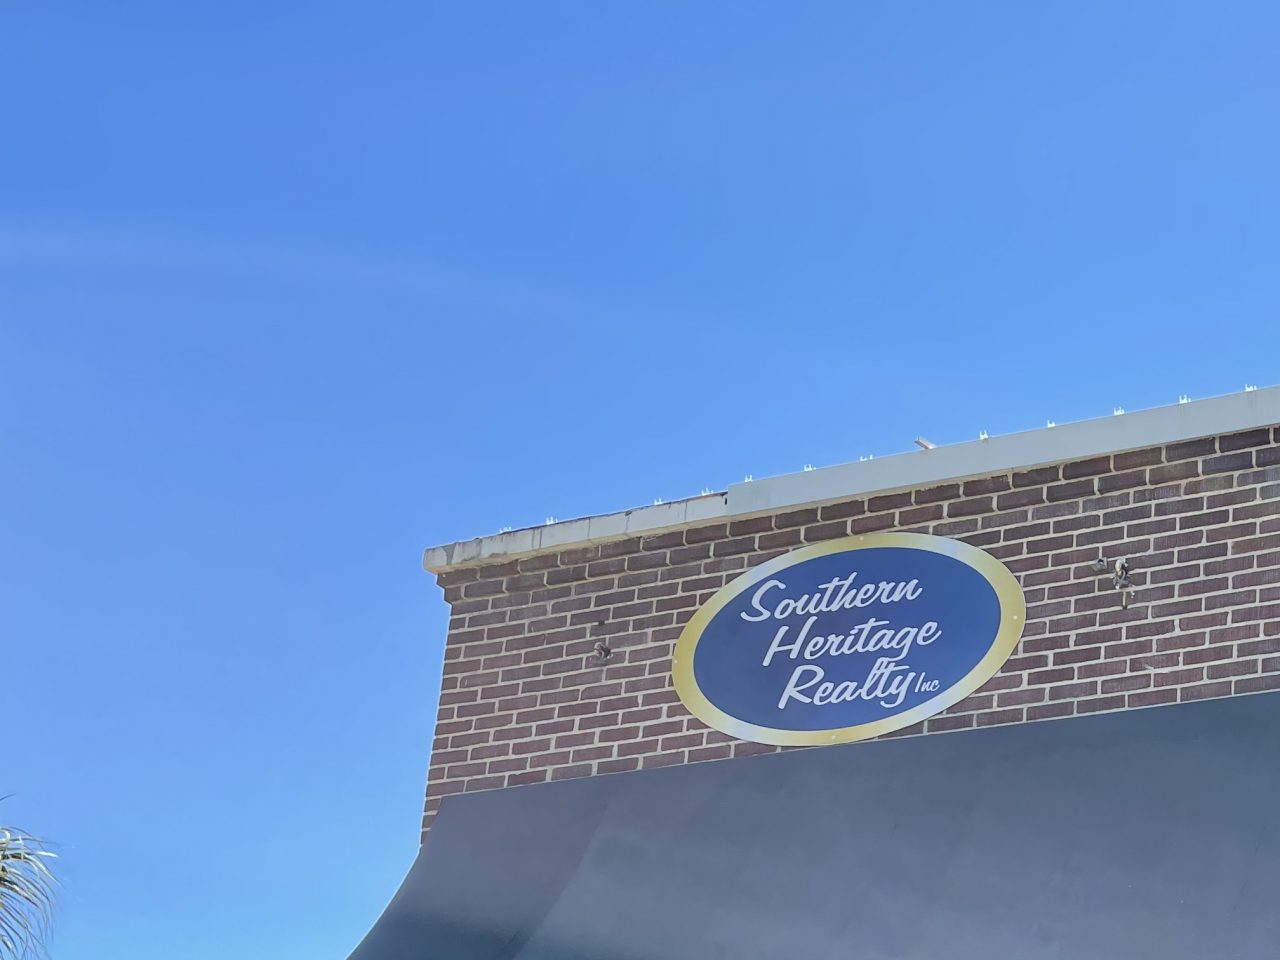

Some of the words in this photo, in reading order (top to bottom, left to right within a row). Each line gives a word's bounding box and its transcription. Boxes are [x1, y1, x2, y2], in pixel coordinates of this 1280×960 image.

[740, 571, 923, 623] Southern
[762, 615, 942, 667] Heritage
[778, 656, 916, 710] Realty
[914, 672, 941, 694] Inc
